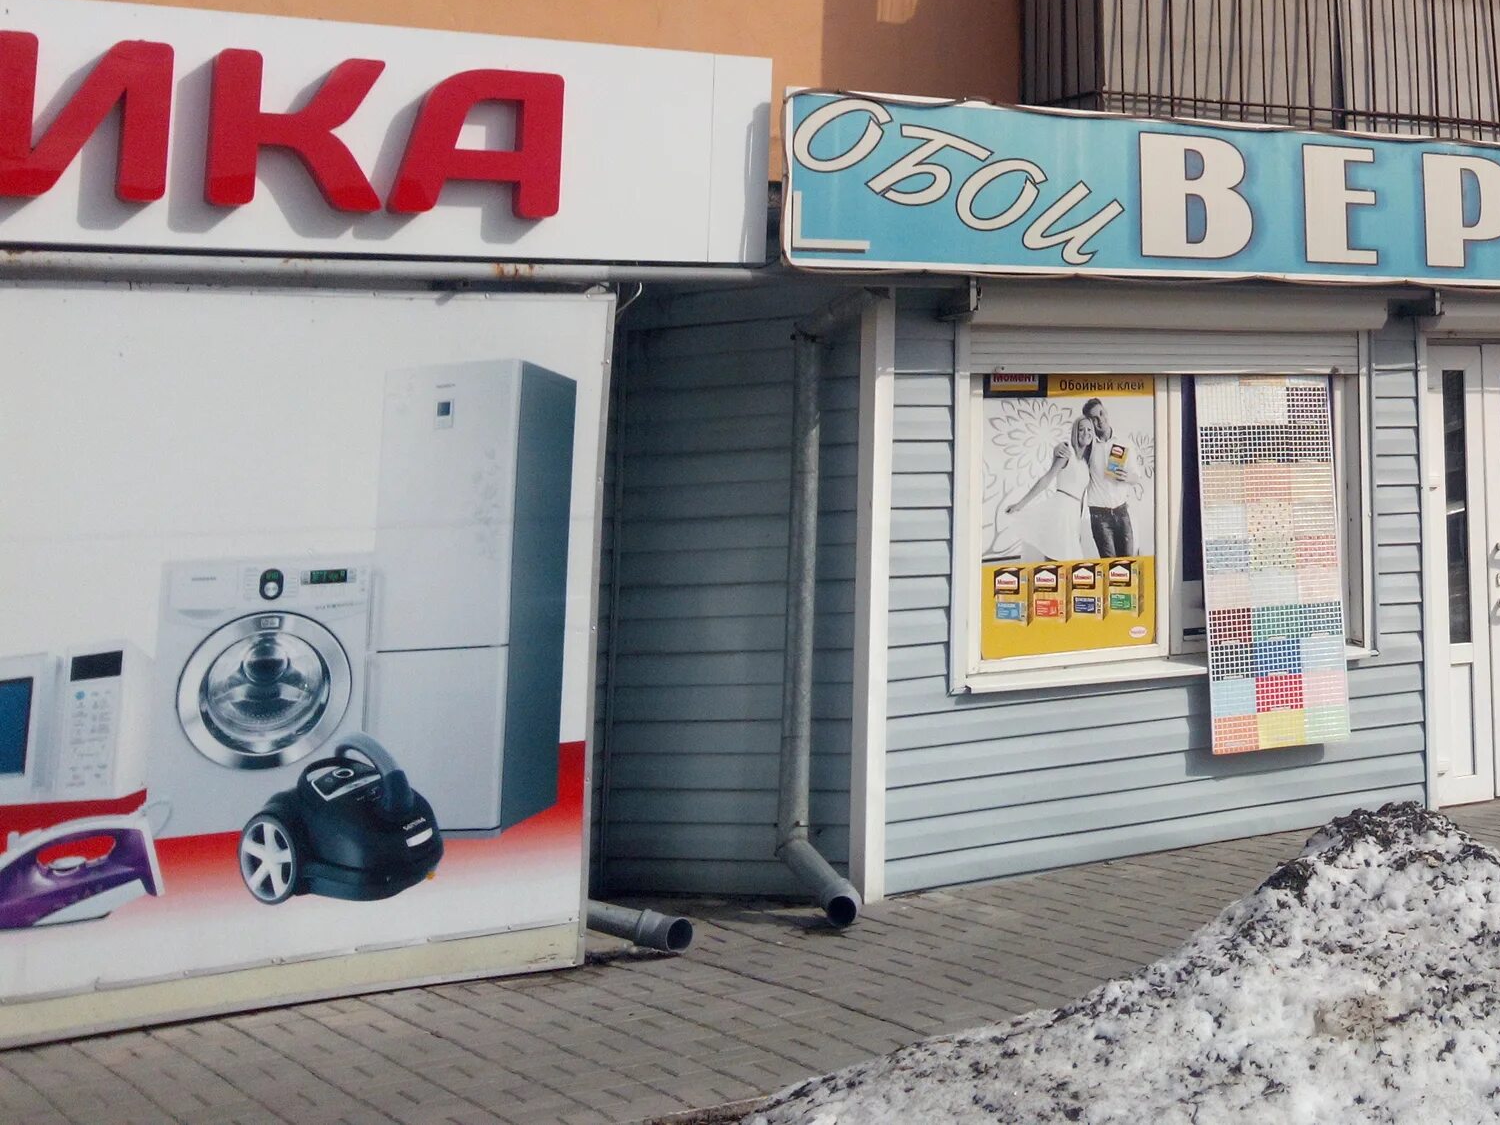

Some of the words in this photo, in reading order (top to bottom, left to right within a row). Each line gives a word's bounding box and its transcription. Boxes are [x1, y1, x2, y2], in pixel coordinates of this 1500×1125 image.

[792, 97, 1125, 266] ОБОИ
[1059, 379, 1114, 392] Обойный
[1116, 378, 1145, 391] клей
